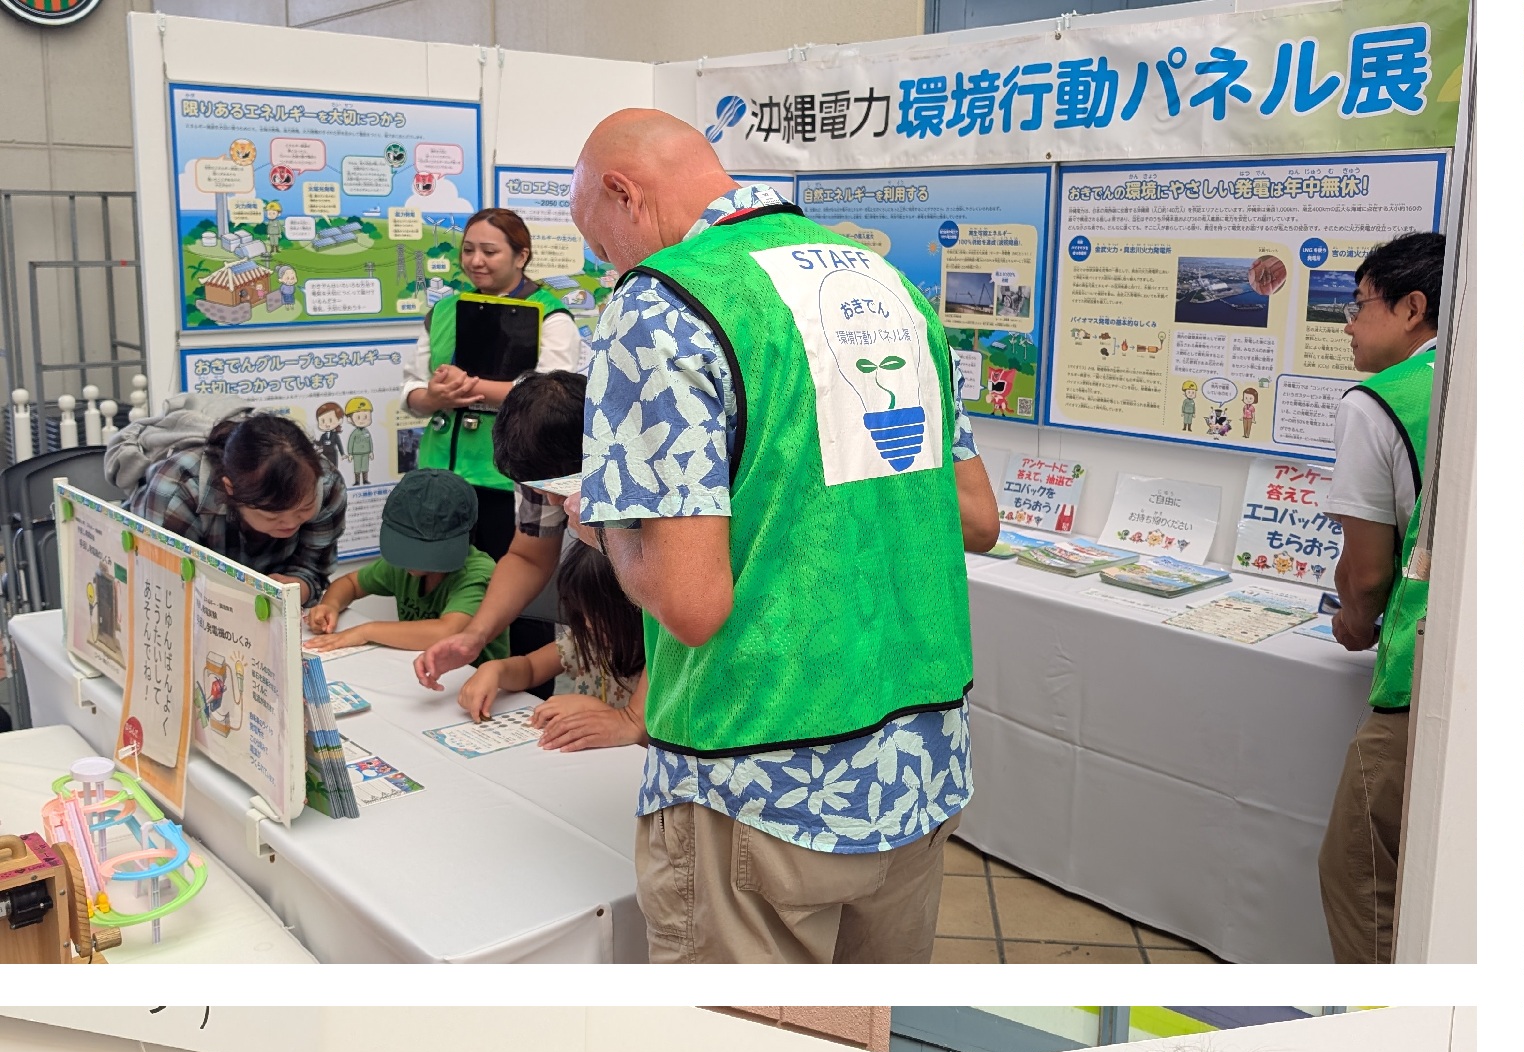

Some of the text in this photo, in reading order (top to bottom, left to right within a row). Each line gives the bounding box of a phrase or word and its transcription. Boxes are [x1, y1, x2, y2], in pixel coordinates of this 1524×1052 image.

[745, 22, 1432, 144] 沖縄電力 環境行動パネル展
[181, 99, 407, 128] 限りあるエネルギーを大切につかう
[804, 185, 929, 204] 自然エネルギーを利用する
[791, 249, 871, 270] STAFF
[840, 298, 890, 320] おきでん
[1070, 317, 1157, 328] バイオマス発電の基本的なしくみ
[835, 328, 912, 346] 環境行動パネル展
[195, 350, 402, 375] おきでんグループもエネルギーを
[195, 373, 339, 394] 大切につかっています
[1022, 458, 1069, 473] アンケートに
[1274, 465, 1333, 485] アンケー
[1017, 469, 1074, 487] 答えて、抽選で
[1148, 494, 1182, 508] ご自由に
[1266, 483, 1319, 507] 答えて、
[1128, 512, 1193, 531] お持ち帰りください
[1266, 530, 1341, 560] もらおう
[152, 585, 162, 705] こうたいして
[162, 589, 173, 736] じゅんばんよく
